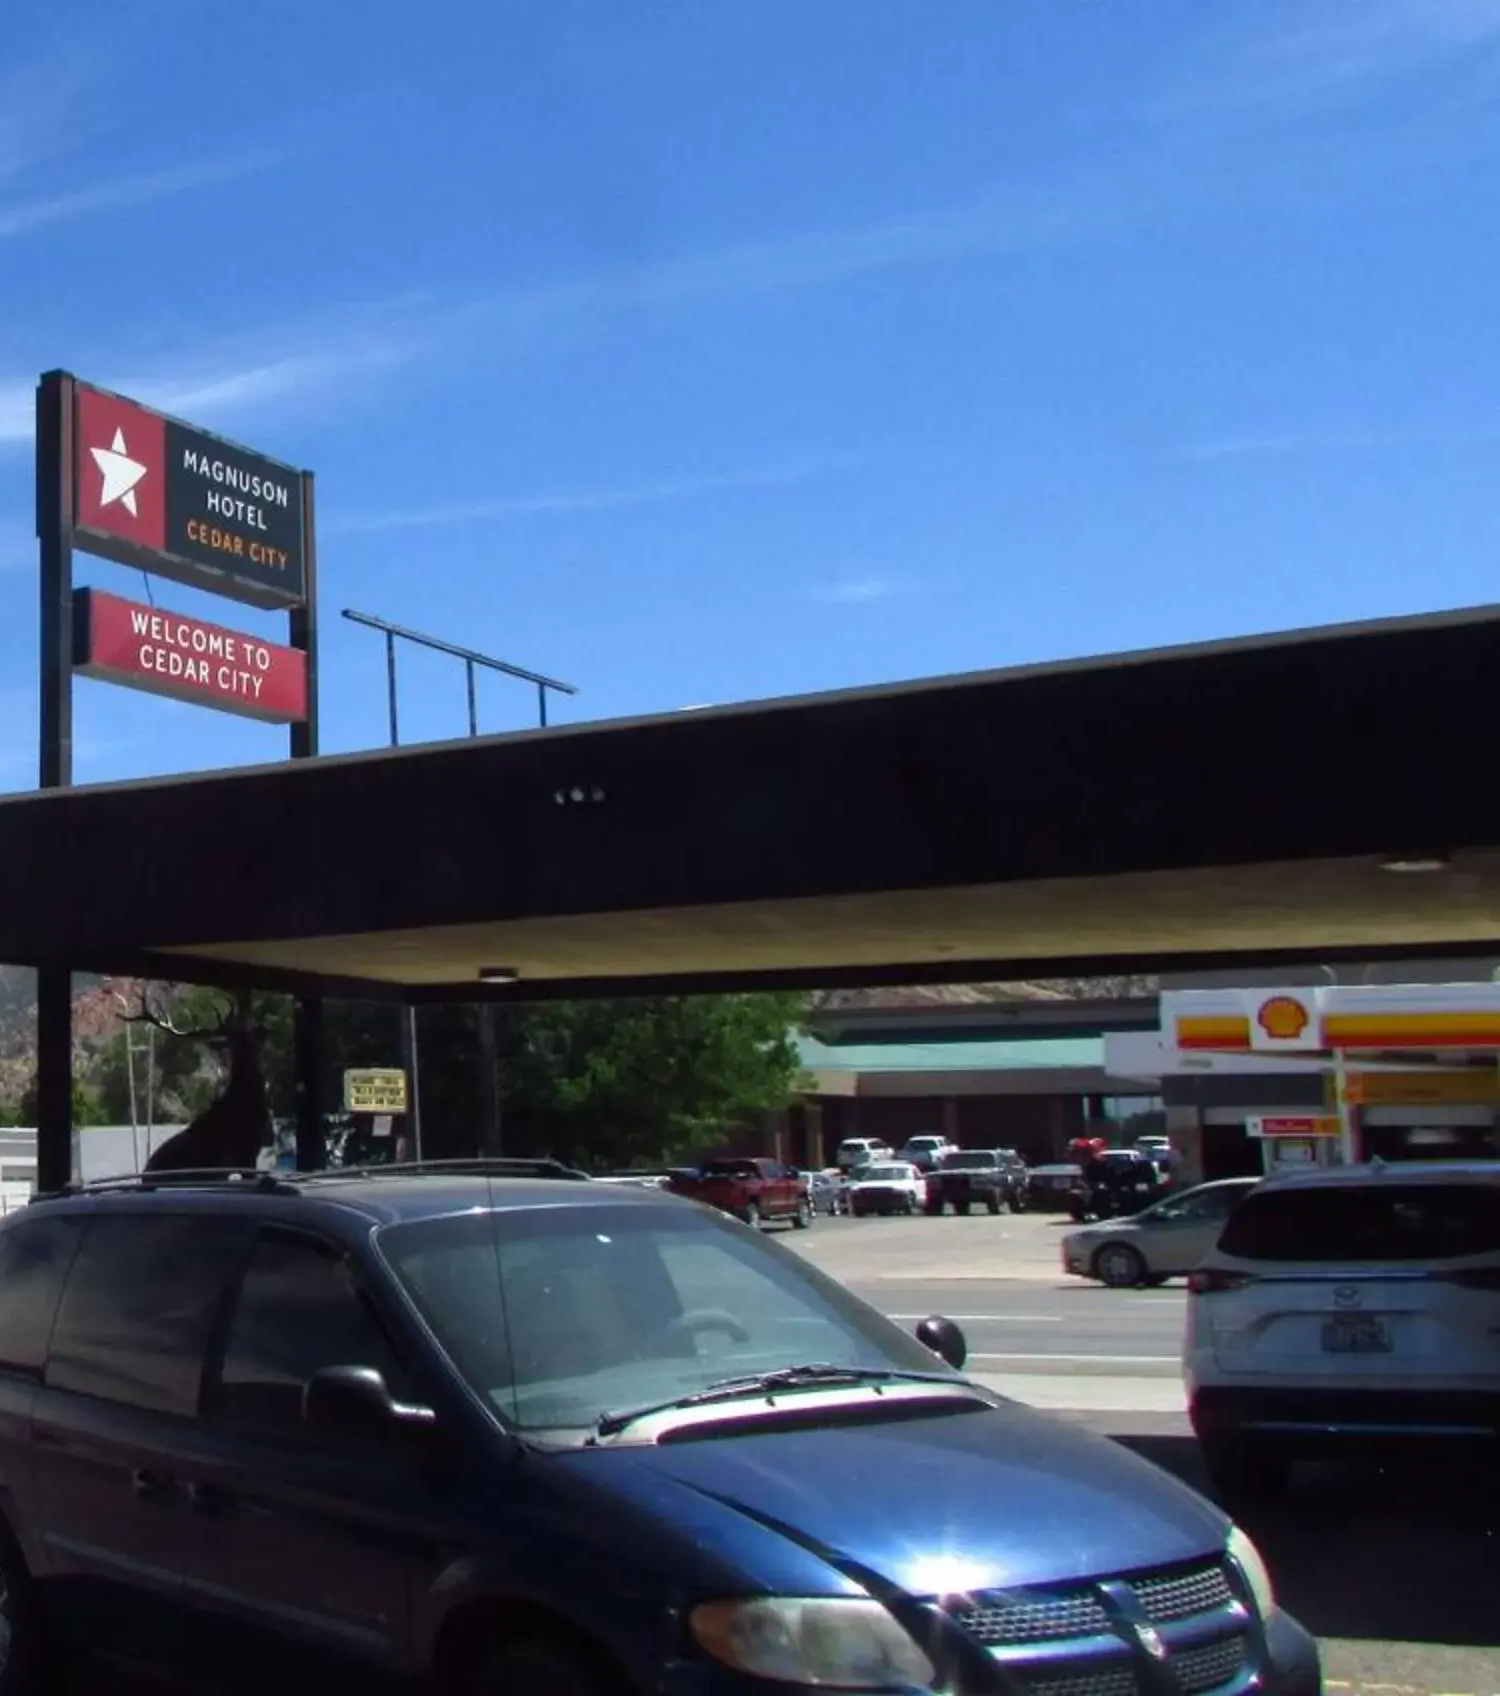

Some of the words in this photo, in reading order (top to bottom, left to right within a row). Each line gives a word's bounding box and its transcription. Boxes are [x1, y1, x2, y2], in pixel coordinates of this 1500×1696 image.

[184, 449, 287, 508] MAGNUSON
[207, 490, 267, 531] HOTEL
[187, 519, 243, 556] CEDAR
[249, 543, 287, 570] CITY
[132, 610, 235, 661] WELCOME
[243, 643, 270, 670] TO
[140, 645, 209, 684] CEDAR
[218, 666, 263, 698] CITY
